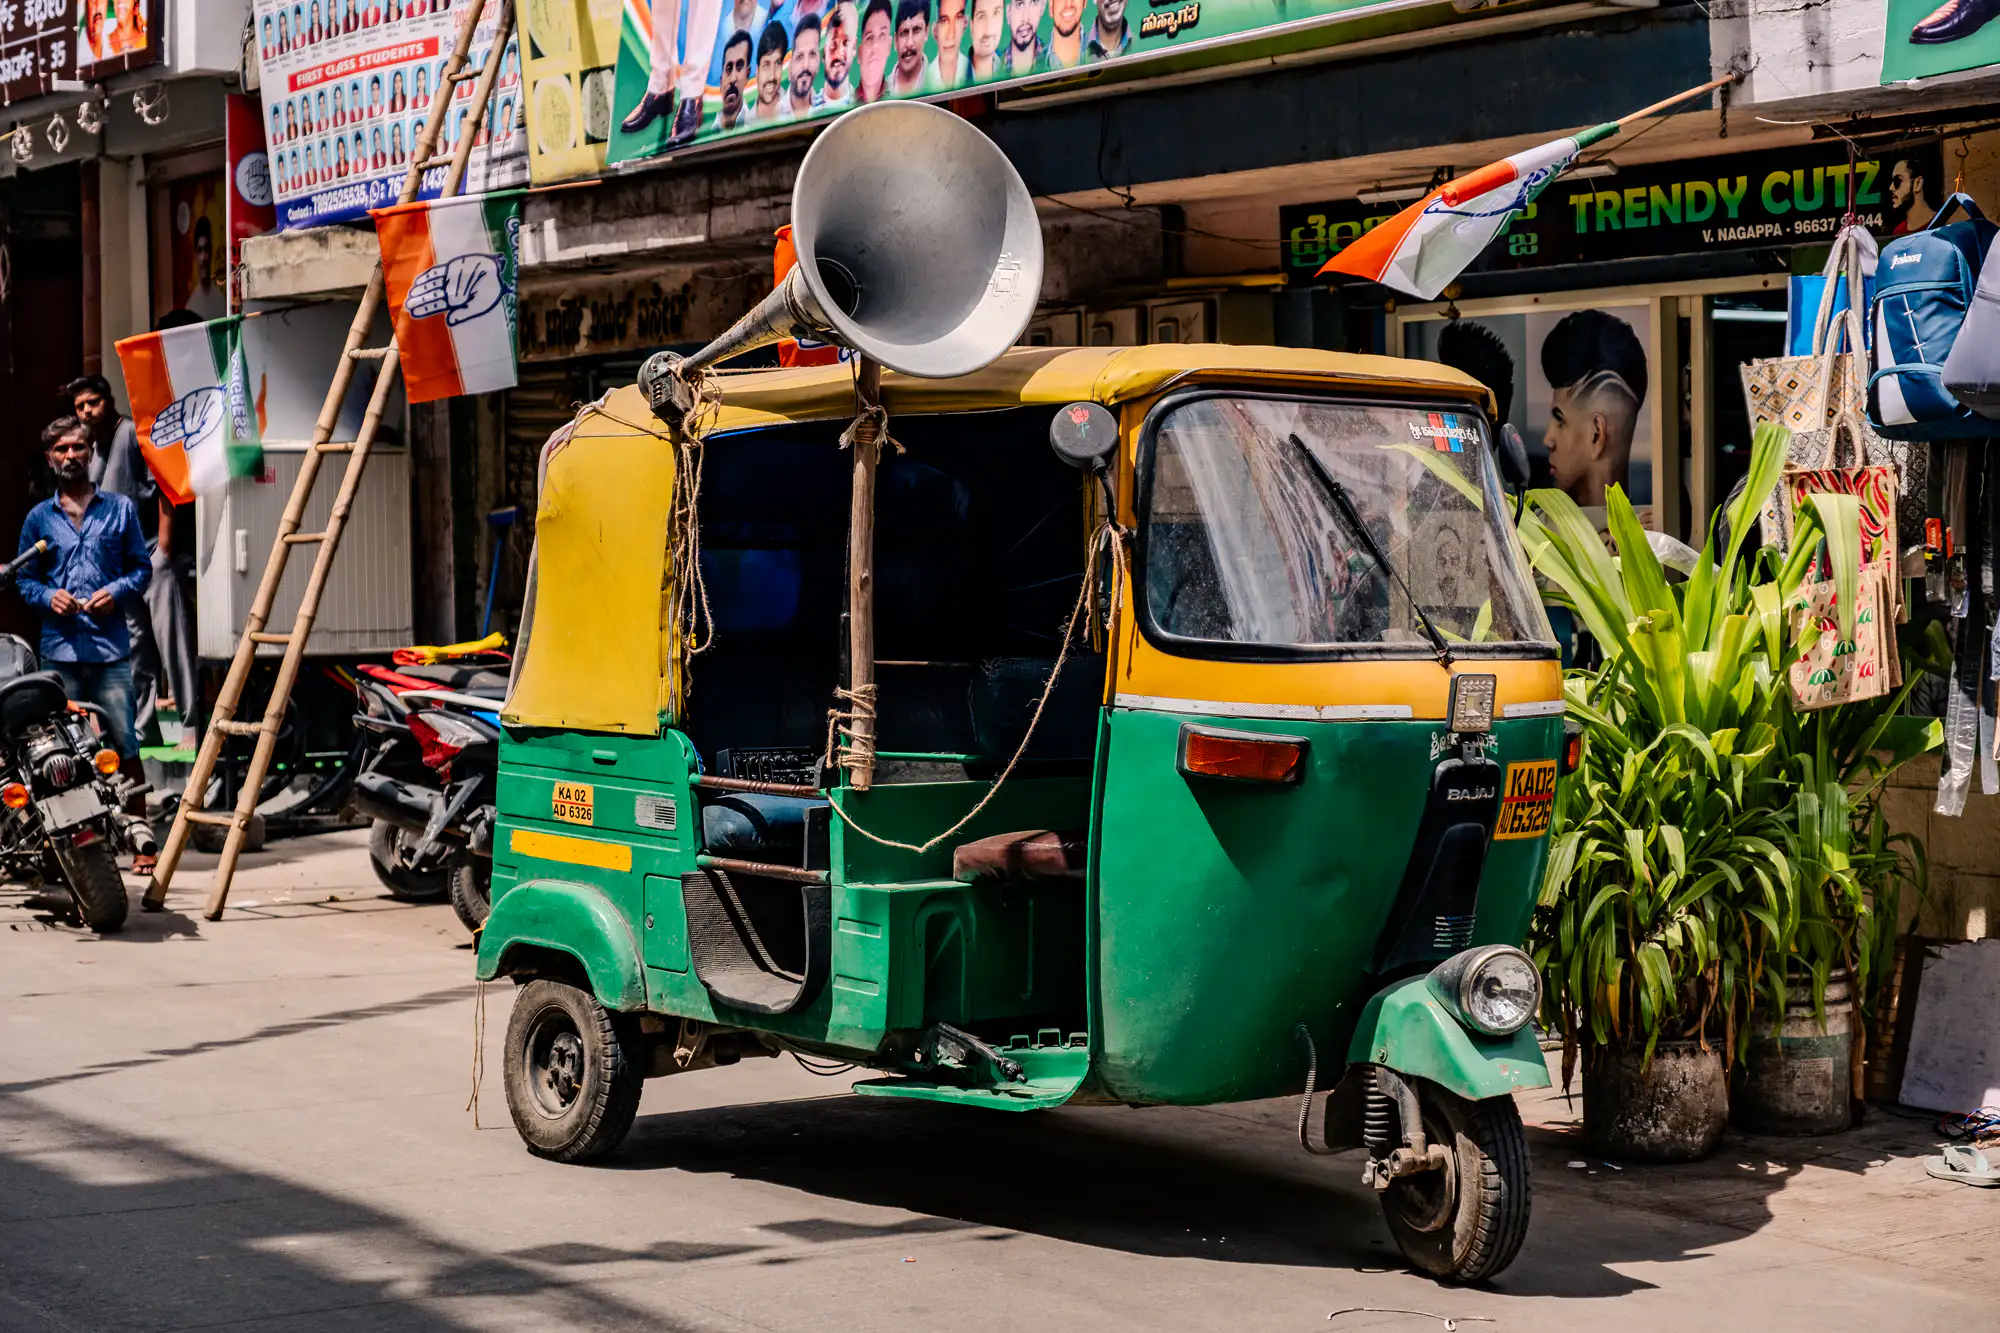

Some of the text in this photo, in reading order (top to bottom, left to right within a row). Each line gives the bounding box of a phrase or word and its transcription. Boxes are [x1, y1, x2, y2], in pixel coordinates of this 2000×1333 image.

[50, 40, 66, 69] 35
[296, 68, 324, 87] FIRST
[325, 57, 357, 77] CLASS
[359, 42, 425, 68] STUDENTS
[1569, 175, 1748, 234] TRENDY
[1761, 159, 1882, 215] CUTZ
[1702, 229, 1714, 243] V.
[1718, 222, 1782, 242] NAGAPPA
[1794, 217, 1837, 235] 96637
[558, 786, 586, 802] KA 02
[553, 803, 592, 821] AD 6326
